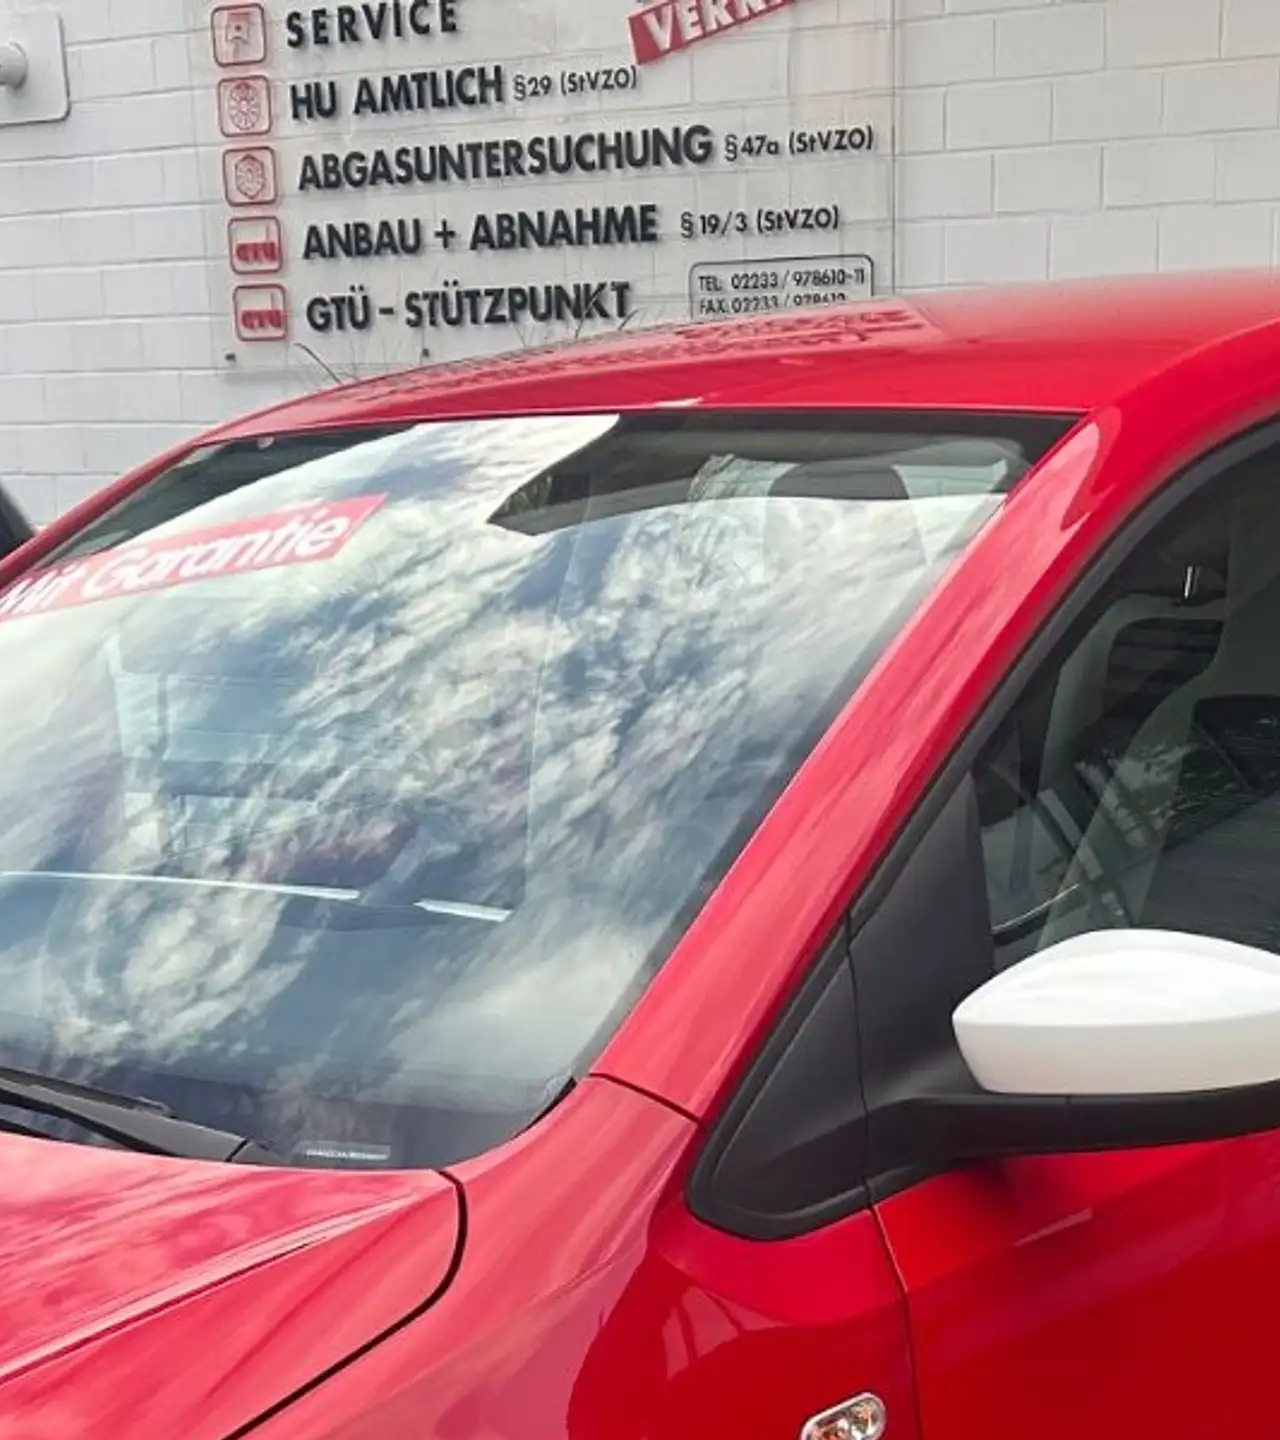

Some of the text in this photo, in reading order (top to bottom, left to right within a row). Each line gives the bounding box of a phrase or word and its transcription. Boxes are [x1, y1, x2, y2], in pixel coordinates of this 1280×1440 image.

[287, 0, 458, 48] SERVICE
[290, 81, 337, 120] HU
[353, 65, 504, 115] AMTLICH
[560, 65, 638, 97] (StVZO)
[297, 125, 713, 193] ABGASUNTERSUCHUNG
[788, 125, 874, 155] (StVZO)
[302, 218, 421, 260] ANBAU
[435, 219, 456, 250] +
[469, 204, 658, 251] ABNAHME
[757, 204, 839, 234] (StVZO)
[306, 285, 370, 332] GTÜ
[405, 280, 630, 327] STÜTZPUNKT
[81, 507, 350, 598] Garantie
